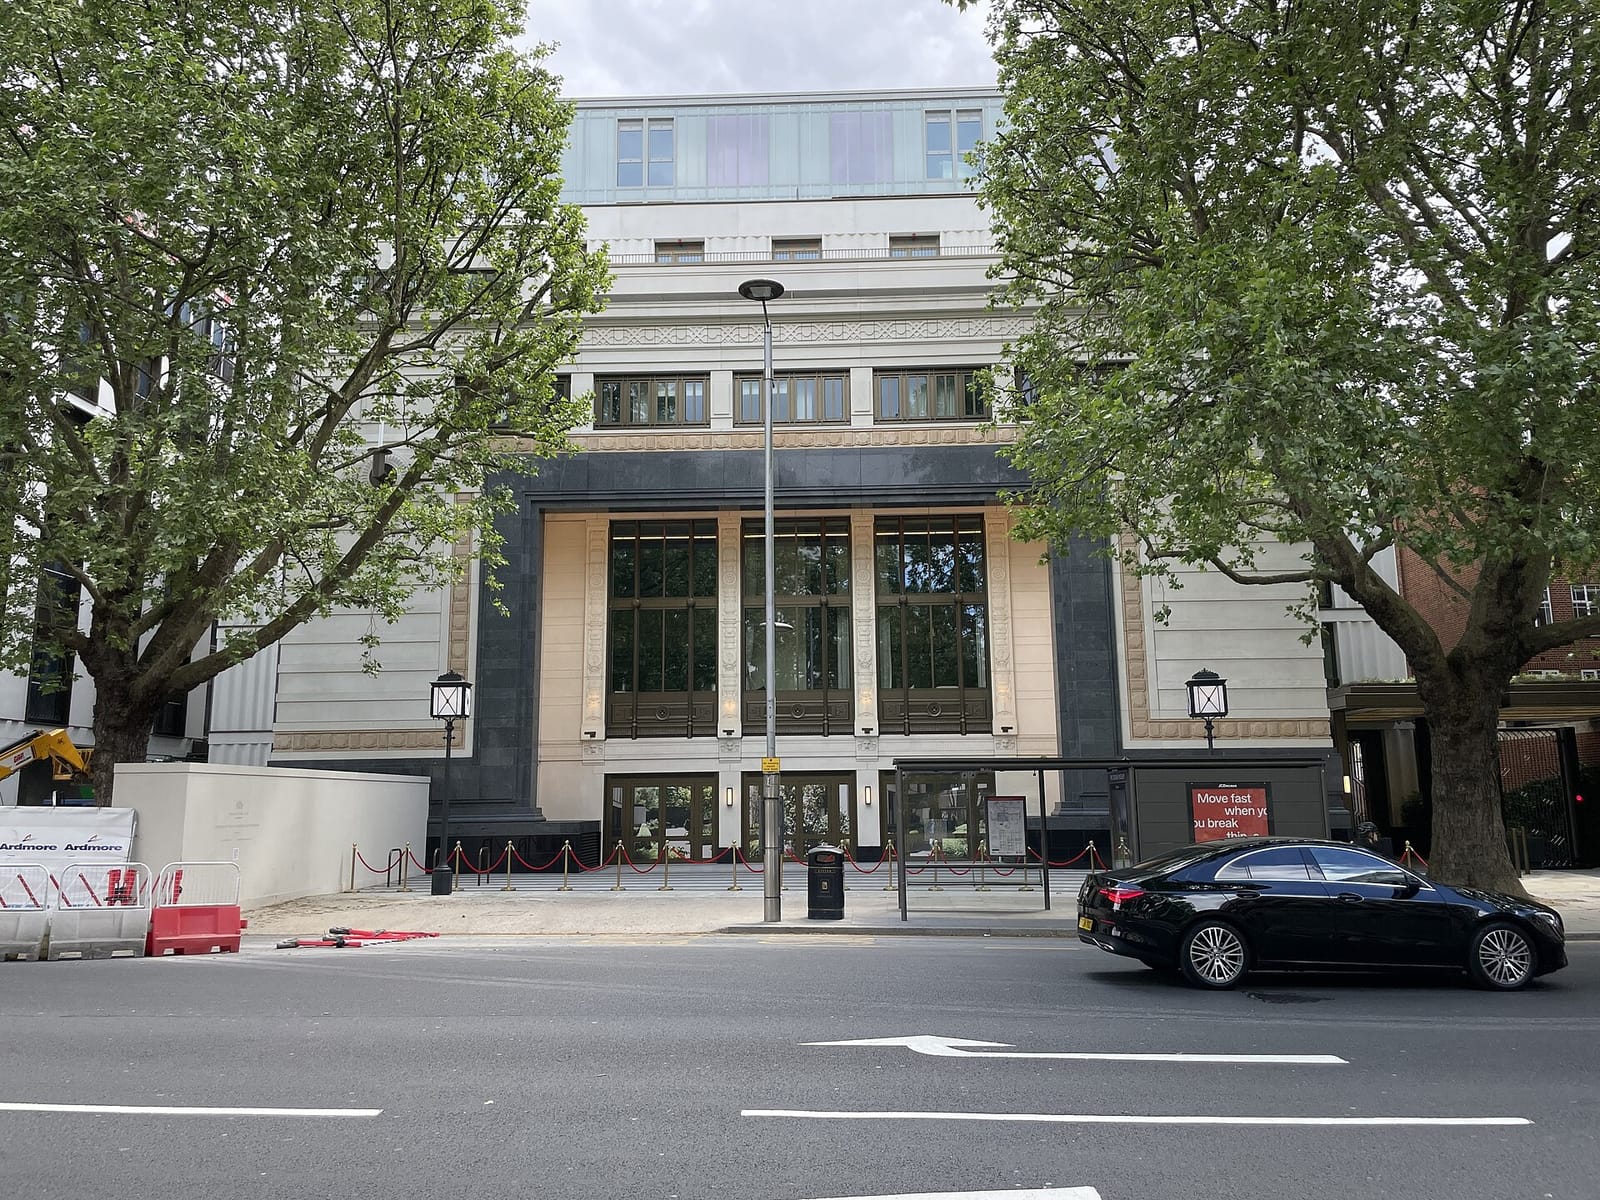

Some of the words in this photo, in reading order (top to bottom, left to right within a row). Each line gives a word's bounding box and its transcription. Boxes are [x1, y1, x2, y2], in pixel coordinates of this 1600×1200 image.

[1197, 793, 1229, 804] Move
[1230, 793, 1252, 804] fast
[1224, 806, 1256, 816] when
[1207, 818, 1239, 828] break
[0, 843, 58, 851] Ardmore
